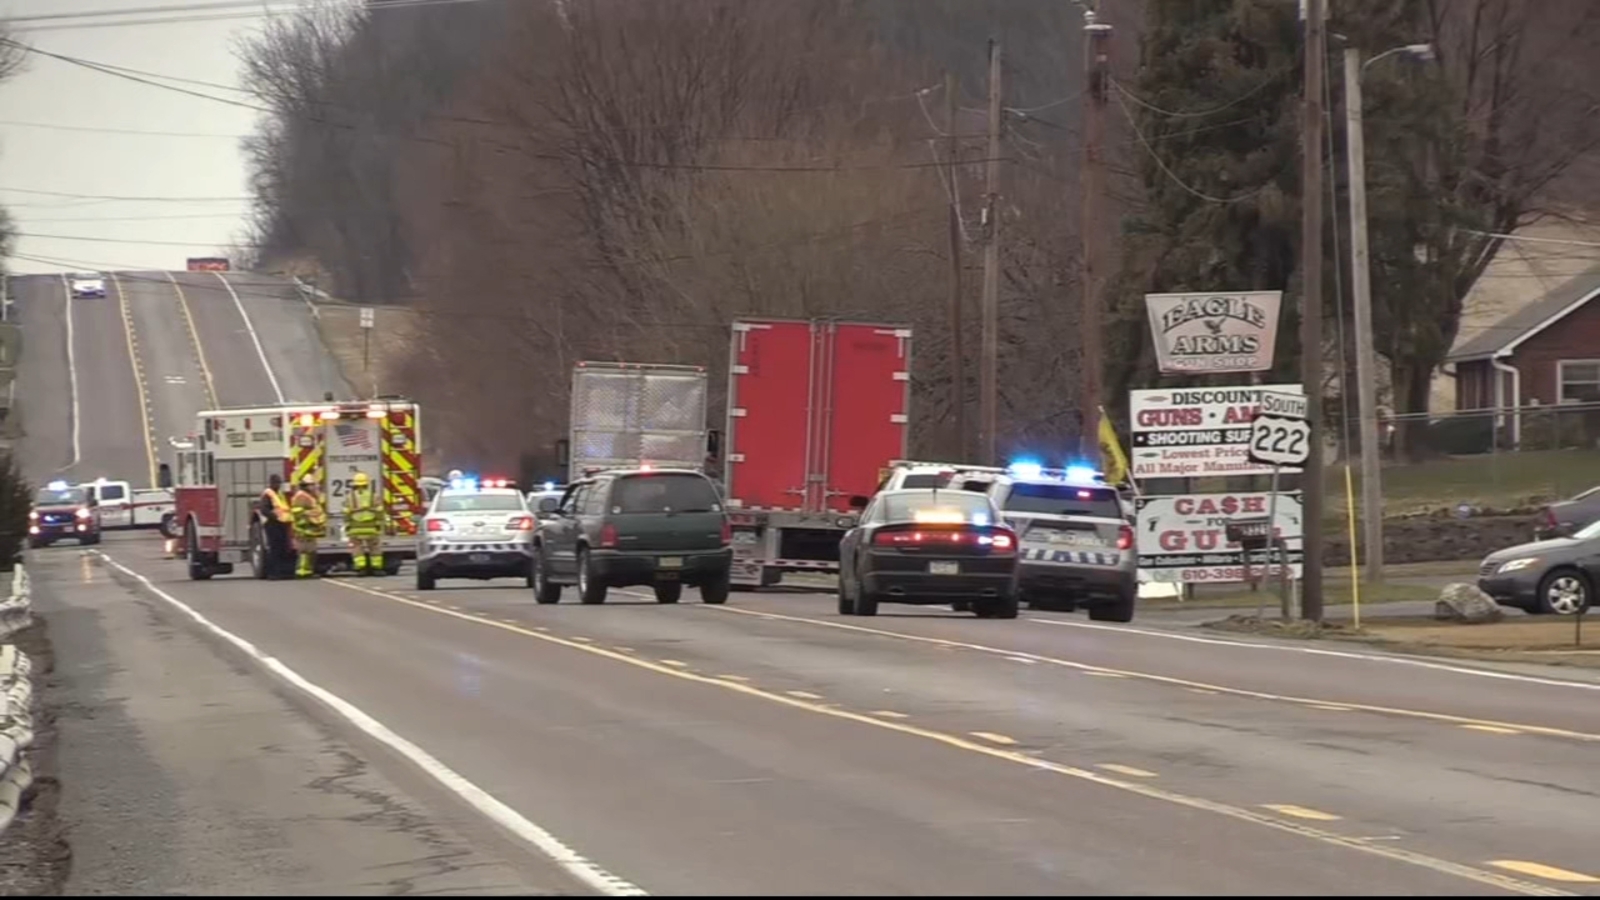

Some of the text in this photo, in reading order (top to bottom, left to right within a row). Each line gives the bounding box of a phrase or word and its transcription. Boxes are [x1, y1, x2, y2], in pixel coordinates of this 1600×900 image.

[1163, 297, 1266, 333] EAGLE
[1170, 334, 1261, 355] ARMS
[1173, 356, 1257, 368] GUN SHOP
[1172, 390, 1262, 405] DISCOUNT
[1264, 394, 1306, 416] SOUTH
[1137, 405, 1261, 427] GUNS AM
[1147, 433, 1221, 445] SHOOTING
[1254, 425, 1305, 455] 222
[1162, 446, 1251, 459] Lowest Price
[1135, 463, 1156, 474] All
[1159, 463, 1198, 474] Major
[332, 479, 376, 497] 251
